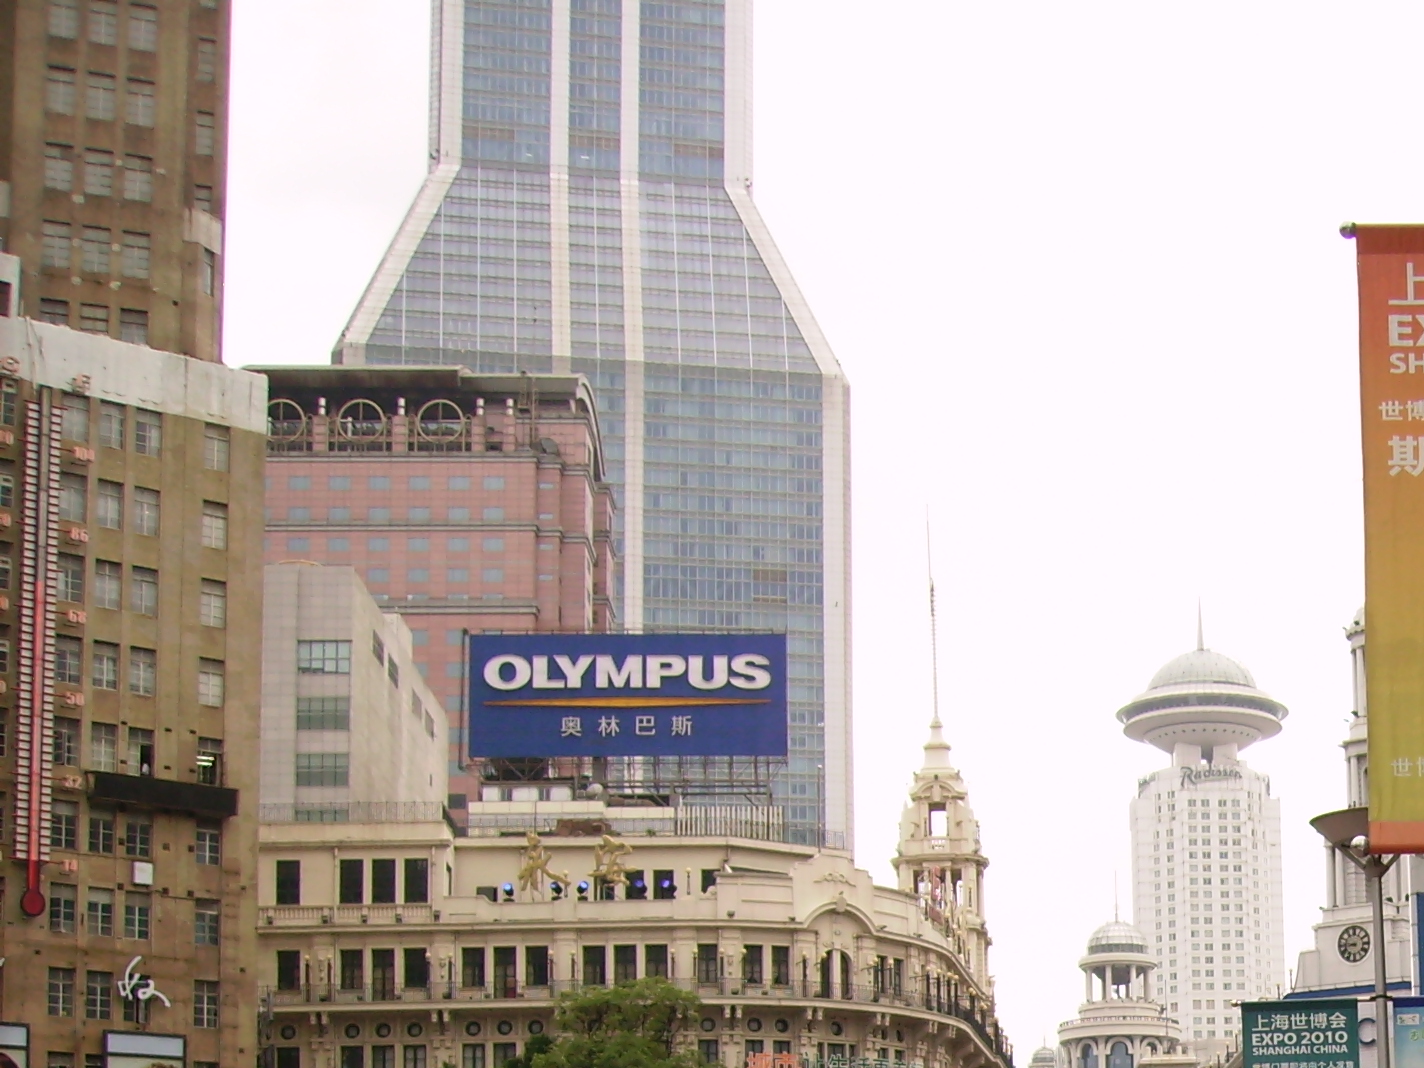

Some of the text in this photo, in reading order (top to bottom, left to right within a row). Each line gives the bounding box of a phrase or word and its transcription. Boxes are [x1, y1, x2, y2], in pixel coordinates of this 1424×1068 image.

[483, 654, 772, 690] OLYMPUS
[561, 715, 693, 737] 奥林巴斯
[1251, 1012, 1348, 1032] 上海世博会
[1251, 1030, 1348, 1046] EXPO 2010
[1252, 1044, 1348, 1056] SHANGHAI CHINA
